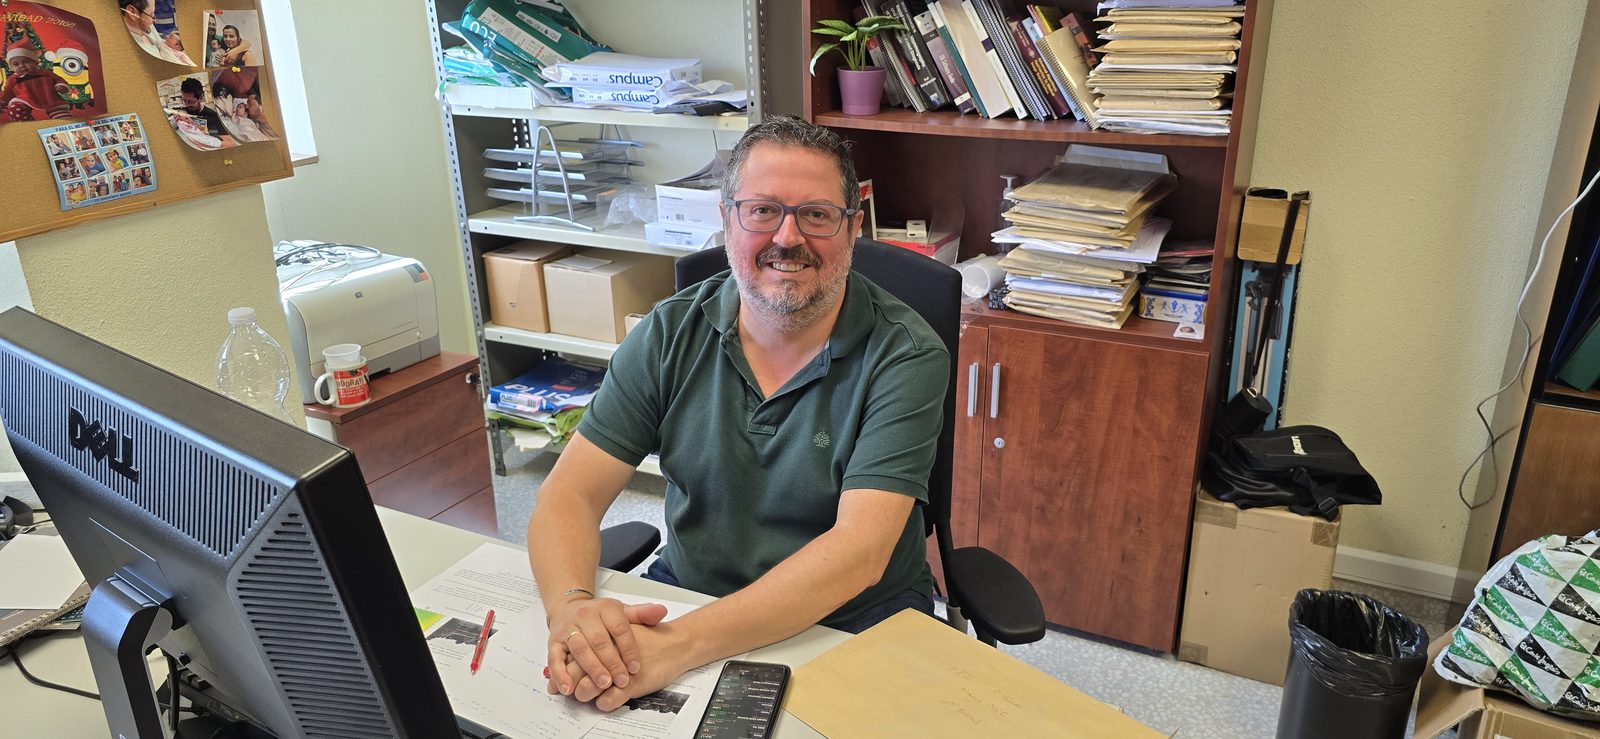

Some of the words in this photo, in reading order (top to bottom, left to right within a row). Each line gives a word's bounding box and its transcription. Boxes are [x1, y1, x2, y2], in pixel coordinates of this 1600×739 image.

[469, 21, 496, 42] ECO
[609, 72, 662, 88] Campus
[611, 90, 660, 105] Campus
[70, 406, 139, 484] DELL
